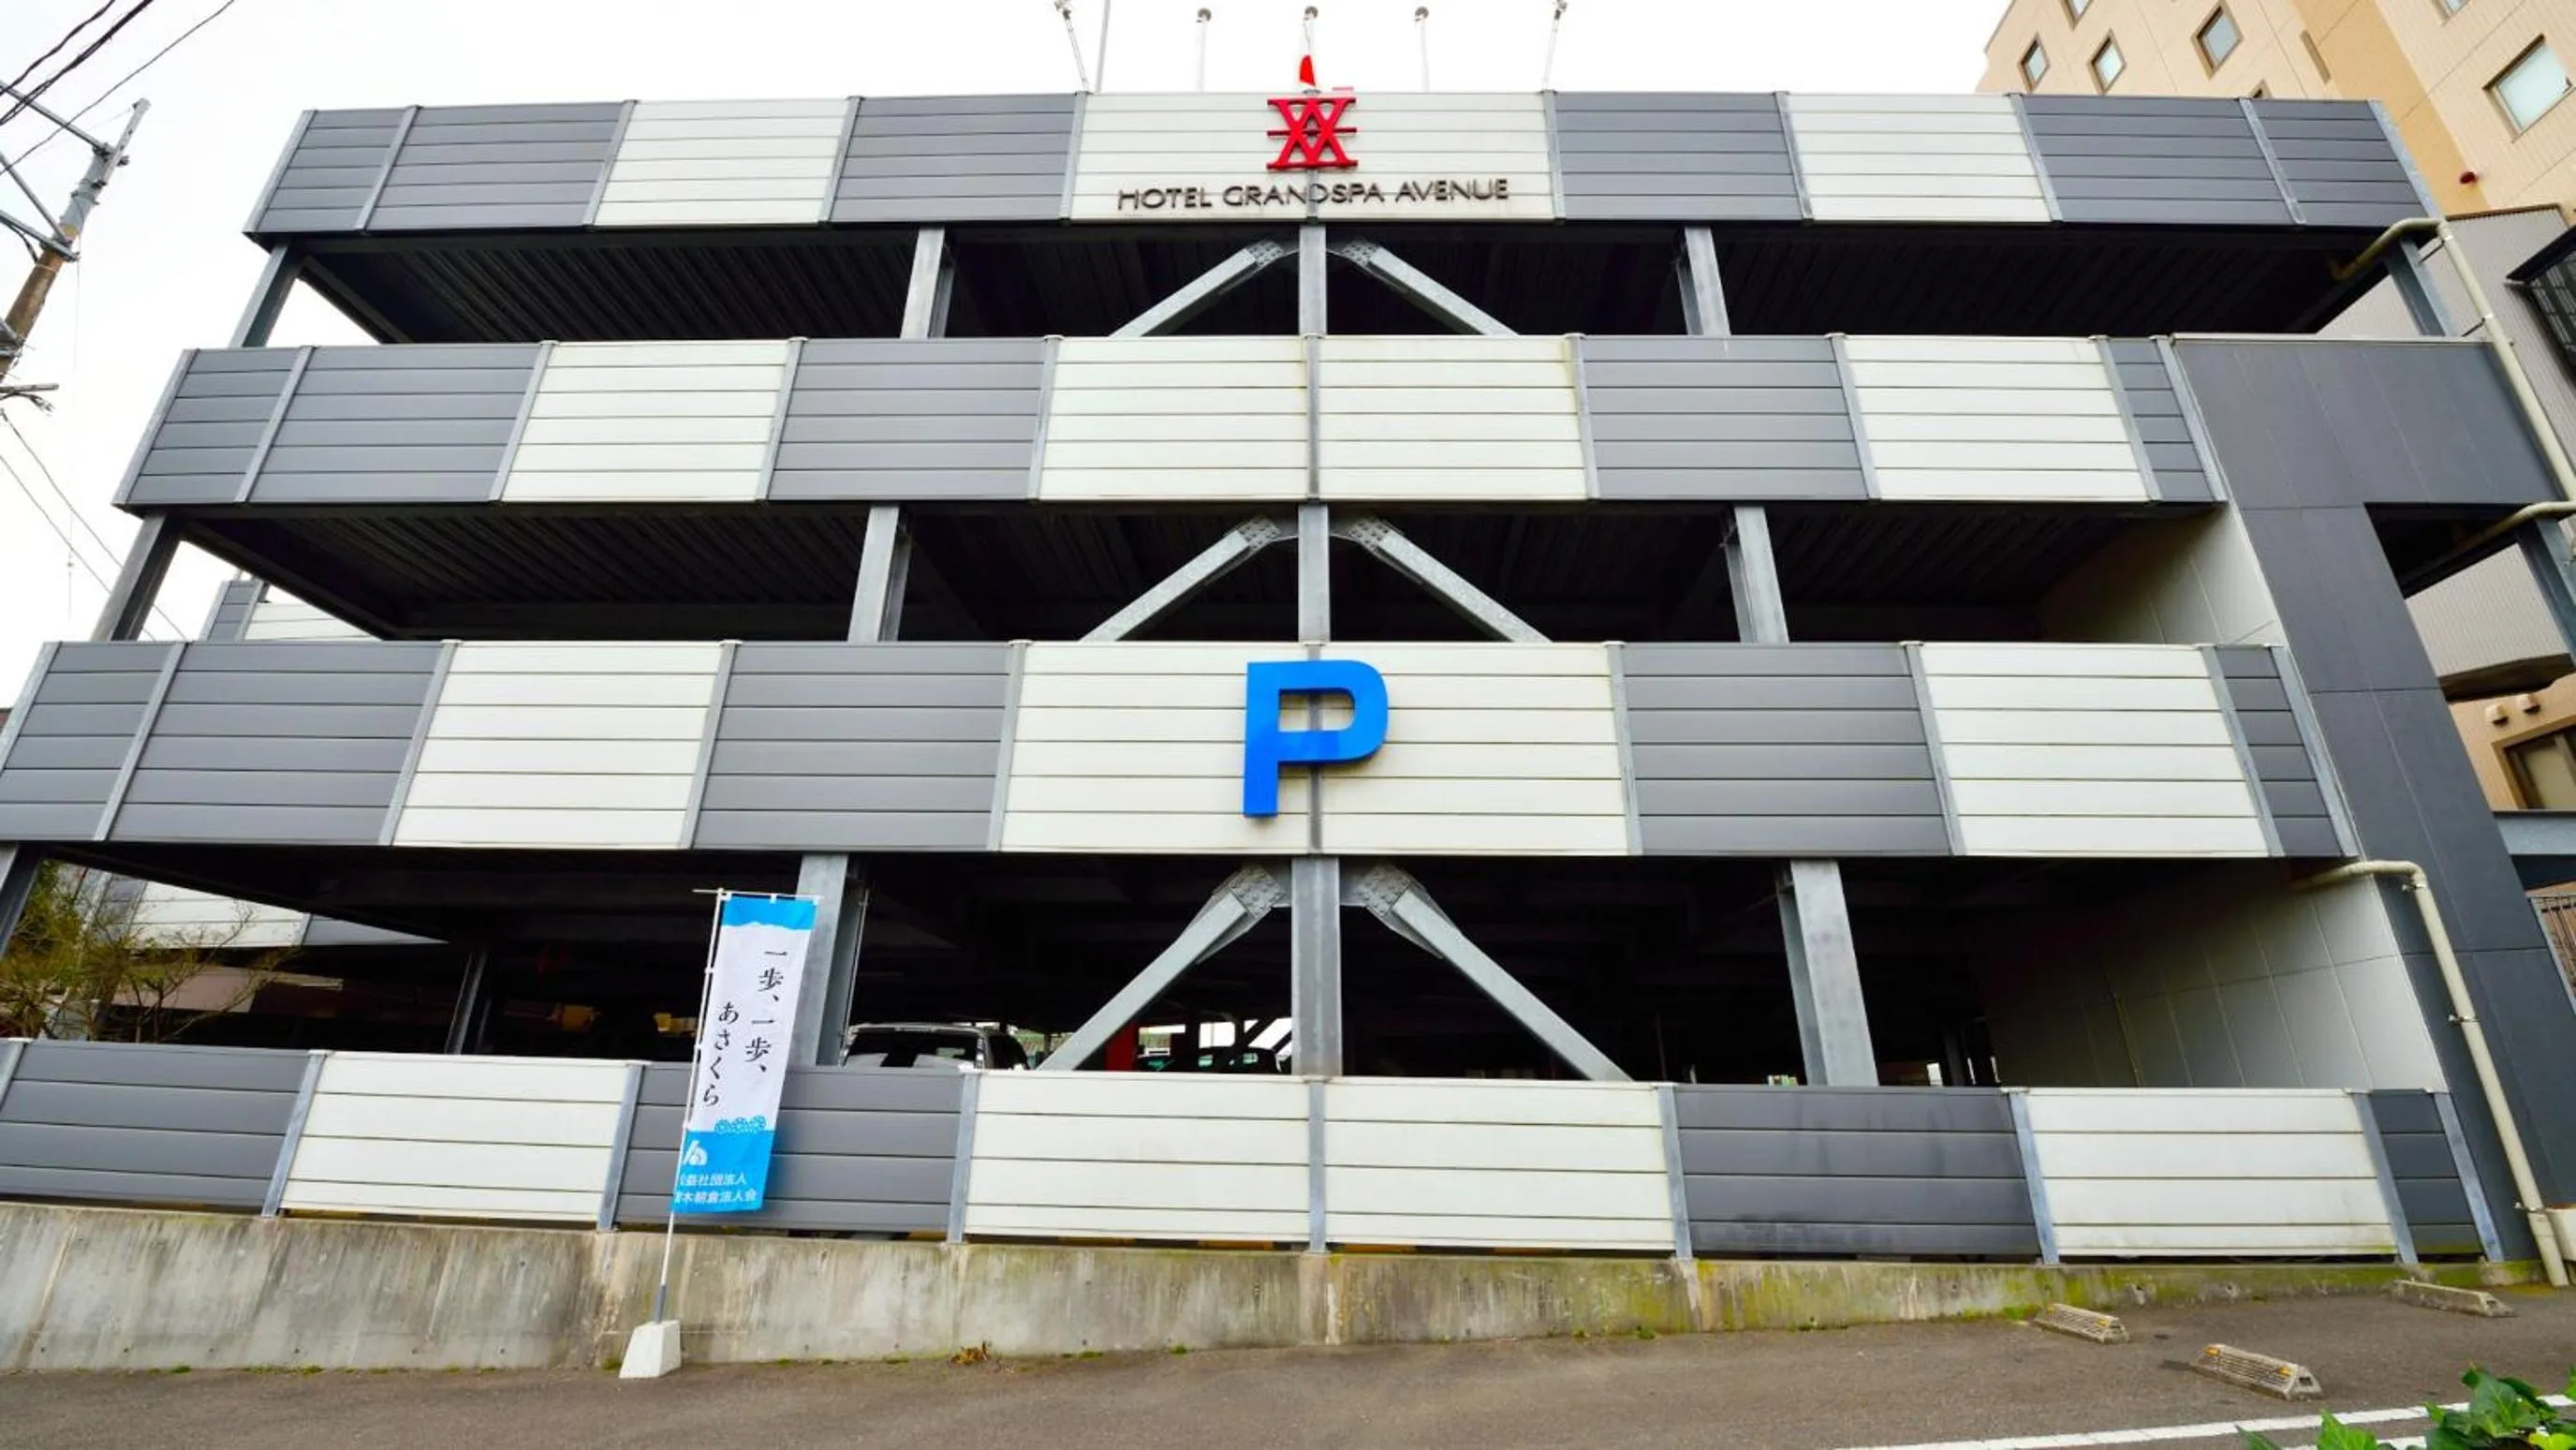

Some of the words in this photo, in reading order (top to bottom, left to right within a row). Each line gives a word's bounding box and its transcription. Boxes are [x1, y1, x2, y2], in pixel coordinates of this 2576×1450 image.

[1118, 186, 1213, 210] HOTEL
[1394, 178, 1509, 203] AVENUE
[1244, 659, 1388, 817] P
[703, 1001, 739, 1107] あさくら
[744, 951, 788, 1073] 一歩、一歩、
